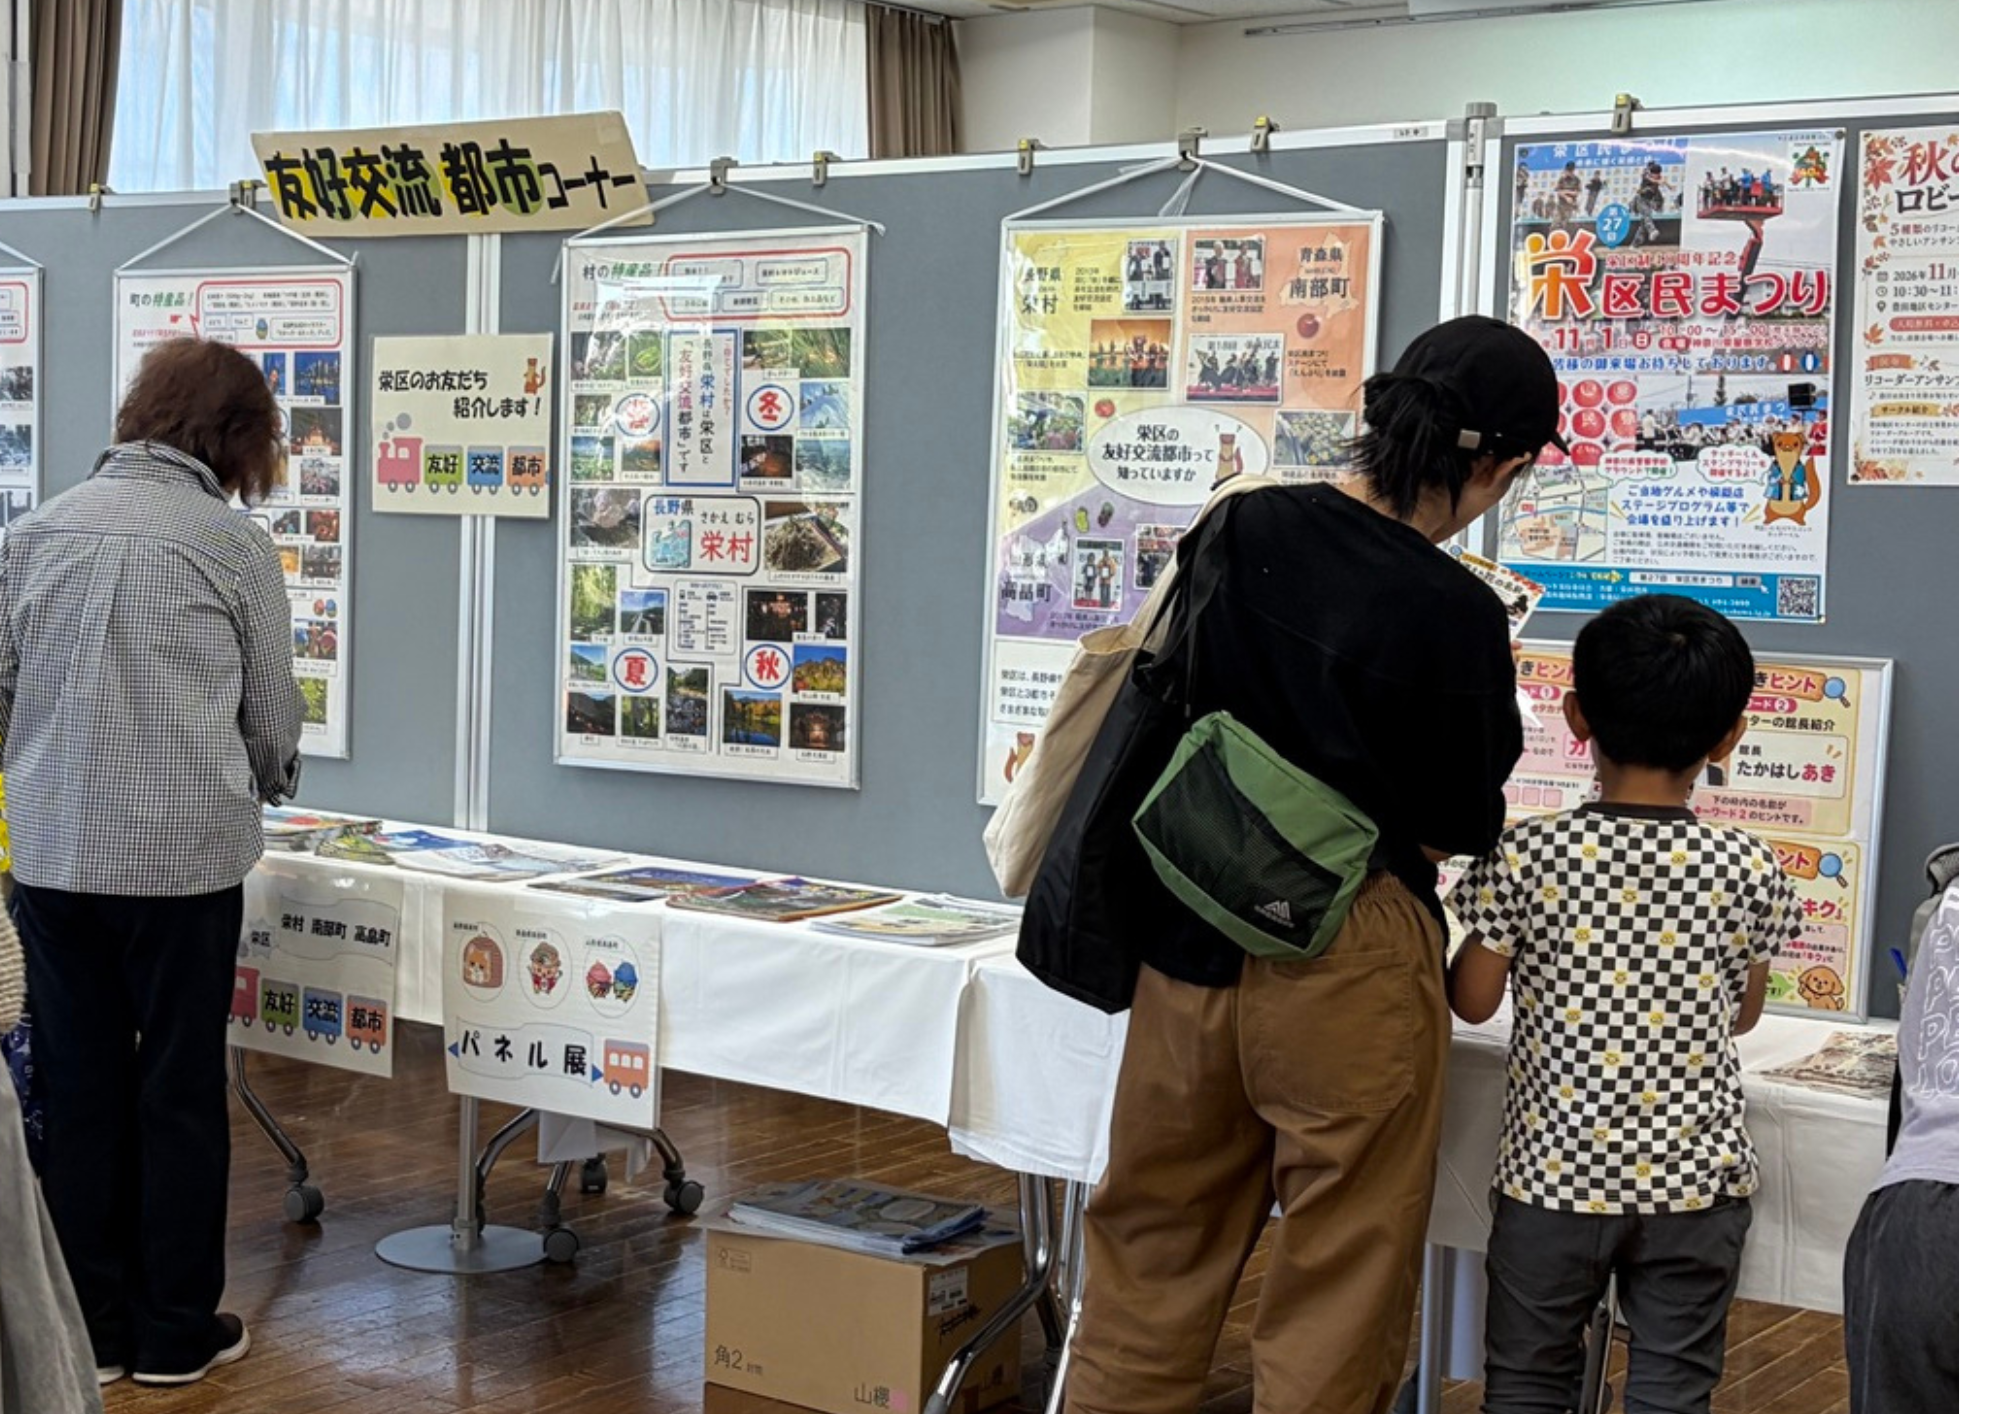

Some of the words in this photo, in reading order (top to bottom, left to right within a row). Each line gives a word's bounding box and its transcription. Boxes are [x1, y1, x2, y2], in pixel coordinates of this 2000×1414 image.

[1899, 141, 1959, 187] 秋
[1602, 217, 1623, 231] 27
[1300, 246, 1343, 262] 青森県
[1288, 278, 1351, 299] 南部町
[378, 370, 488, 391] 栄区のお友だち
[453, 396, 541, 419] 紹介します！
[758, 391, 782, 422] 冬
[1136, 424, 1179, 441] 栄区の
[428, 454, 458, 474] 友好
[1102, 442, 1213, 465] 友好交流都市って
[471, 456, 500, 476] 交流
[512, 456, 542, 477] 都市
[1117, 466, 1196, 483] 知っていますか
[654, 498, 694, 517] 長野県
[701, 511, 729, 525] さかえ
[735, 512, 755, 525] むら
[700, 530, 754, 563] 栄村
[624, 656, 648, 685] 夏
[756, 650, 779, 681] 秋
[1737, 761, 1836, 783] たかはしあき
[251, 931, 272, 948] 栄区
[281, 913, 305, 932] 栄村
[311, 918, 347, 940] 南部町
[354, 924, 392, 948] 高畠町
[264, 989, 295, 1016] 友好
[306, 998, 339, 1025] 交流
[351, 1004, 384, 1033] 都市
[714, 1344, 743, 1369] 角2
